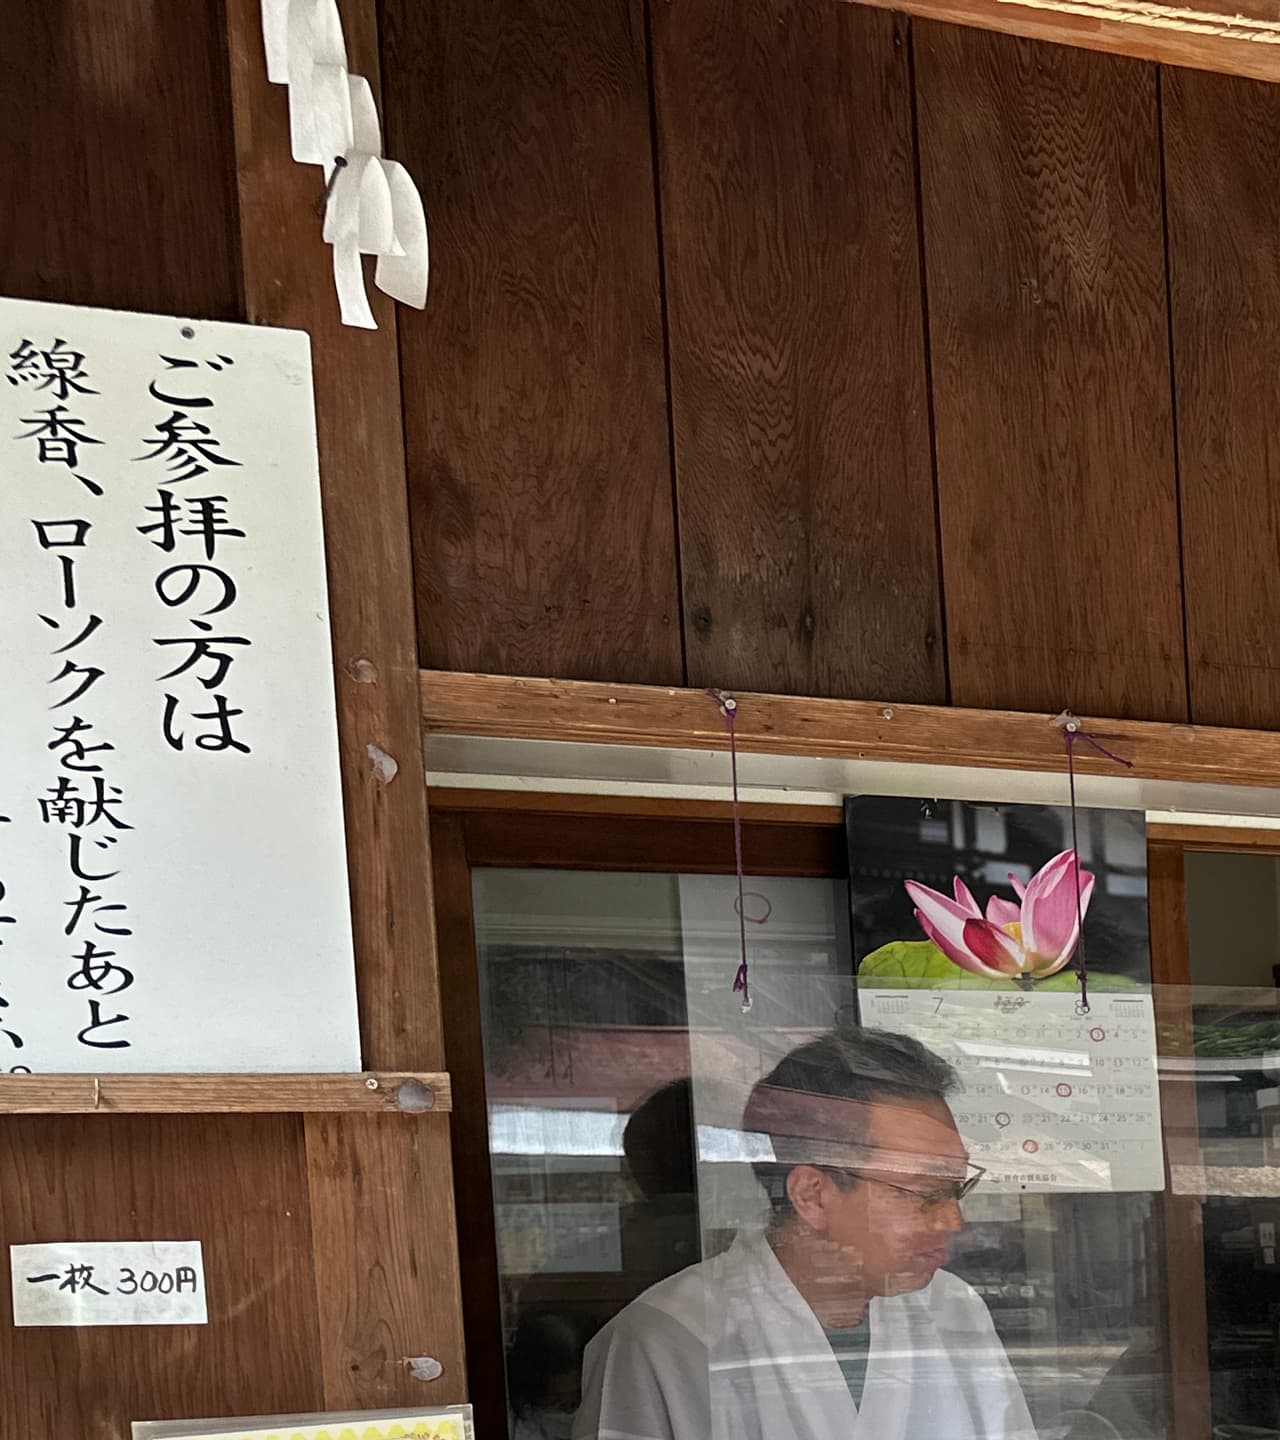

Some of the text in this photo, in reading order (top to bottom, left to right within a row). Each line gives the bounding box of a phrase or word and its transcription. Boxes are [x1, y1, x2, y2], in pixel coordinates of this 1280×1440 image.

[3, 338, 135, 1049] 線香、ローソクを献じたあと
[131, 353, 252, 754] ご参拝の方は
[26, 1264, 197, 1295] 一枚 300円
